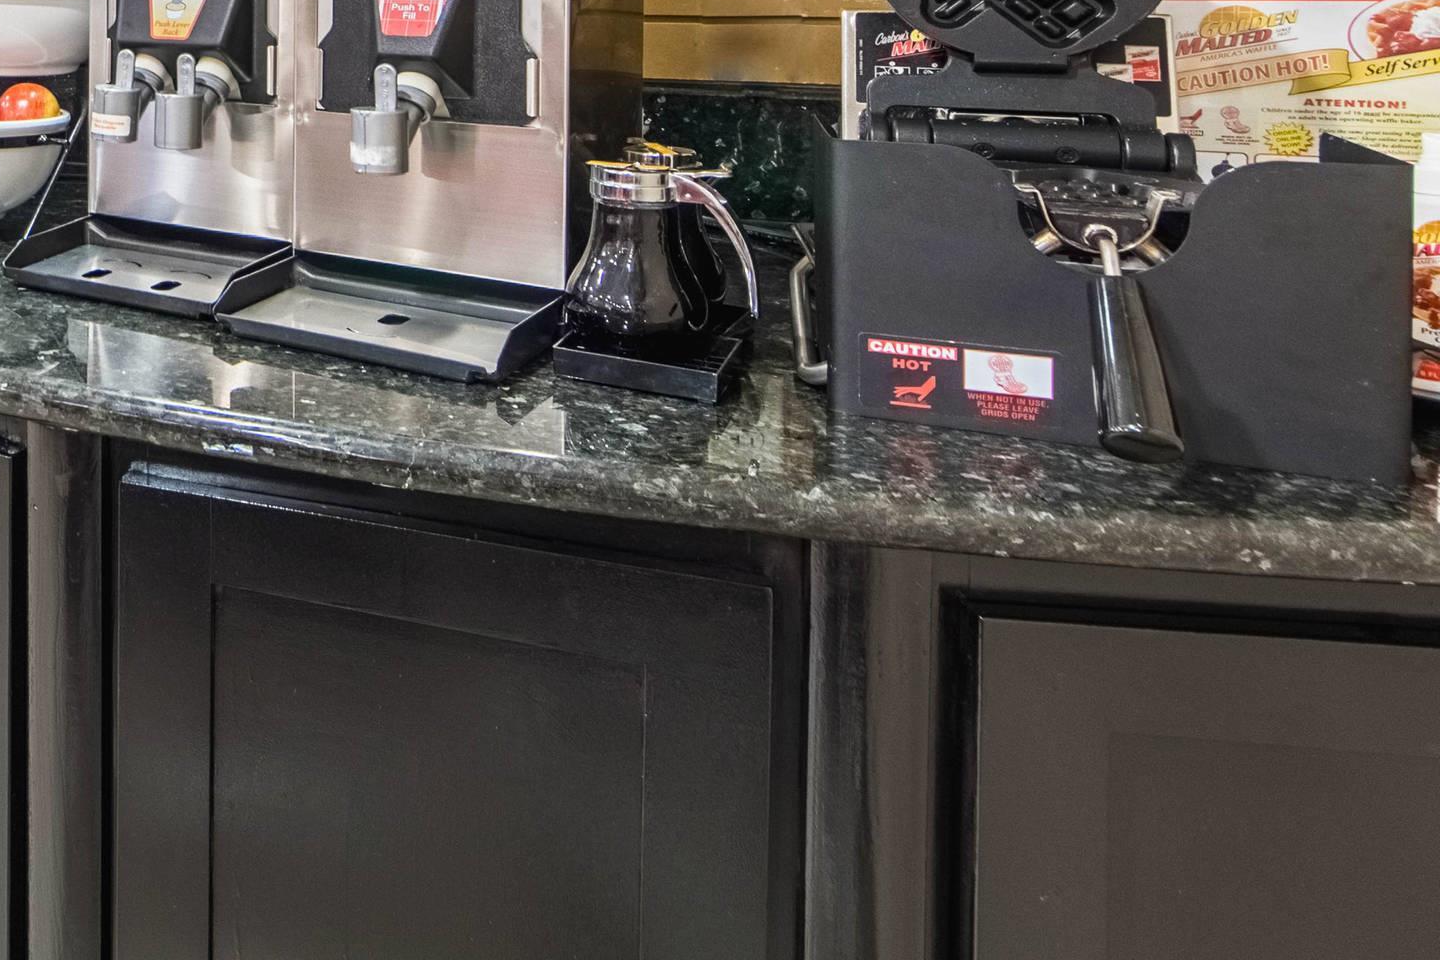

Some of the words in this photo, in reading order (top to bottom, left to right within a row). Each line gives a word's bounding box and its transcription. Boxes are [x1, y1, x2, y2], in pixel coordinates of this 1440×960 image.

[391, 3, 416, 11] Push
[417, 3, 430, 12] To
[402, 11, 417, 19] Fill
[1199, 8, 1299, 38] GOLDEN
[874, 30, 910, 46] Carbon's
[1175, 28, 1273, 57] MALTED
[1244, 43, 1278, 55] WAFFLE
[1177, 64, 1270, 92] CAUTION
[1276, 54, 1330, 76] HOT!
[1365, 59, 1400, 77] Self
[1303, 98, 1408, 110] ATTENTION!
[870, 342, 957, 359] CAUTION
[892, 358, 931, 372] HOT
[967, 392, 994, 401] WHEN
[996, 396, 1014, 404] NOT
[1016, 398, 1026, 406] IN
[976, 401, 1010, 411] PLEASE
[1012, 405, 1040, 415] LEAVE
[981, 408, 1009, 418] GRIDS
[1011, 412, 1036, 421] OPEN
